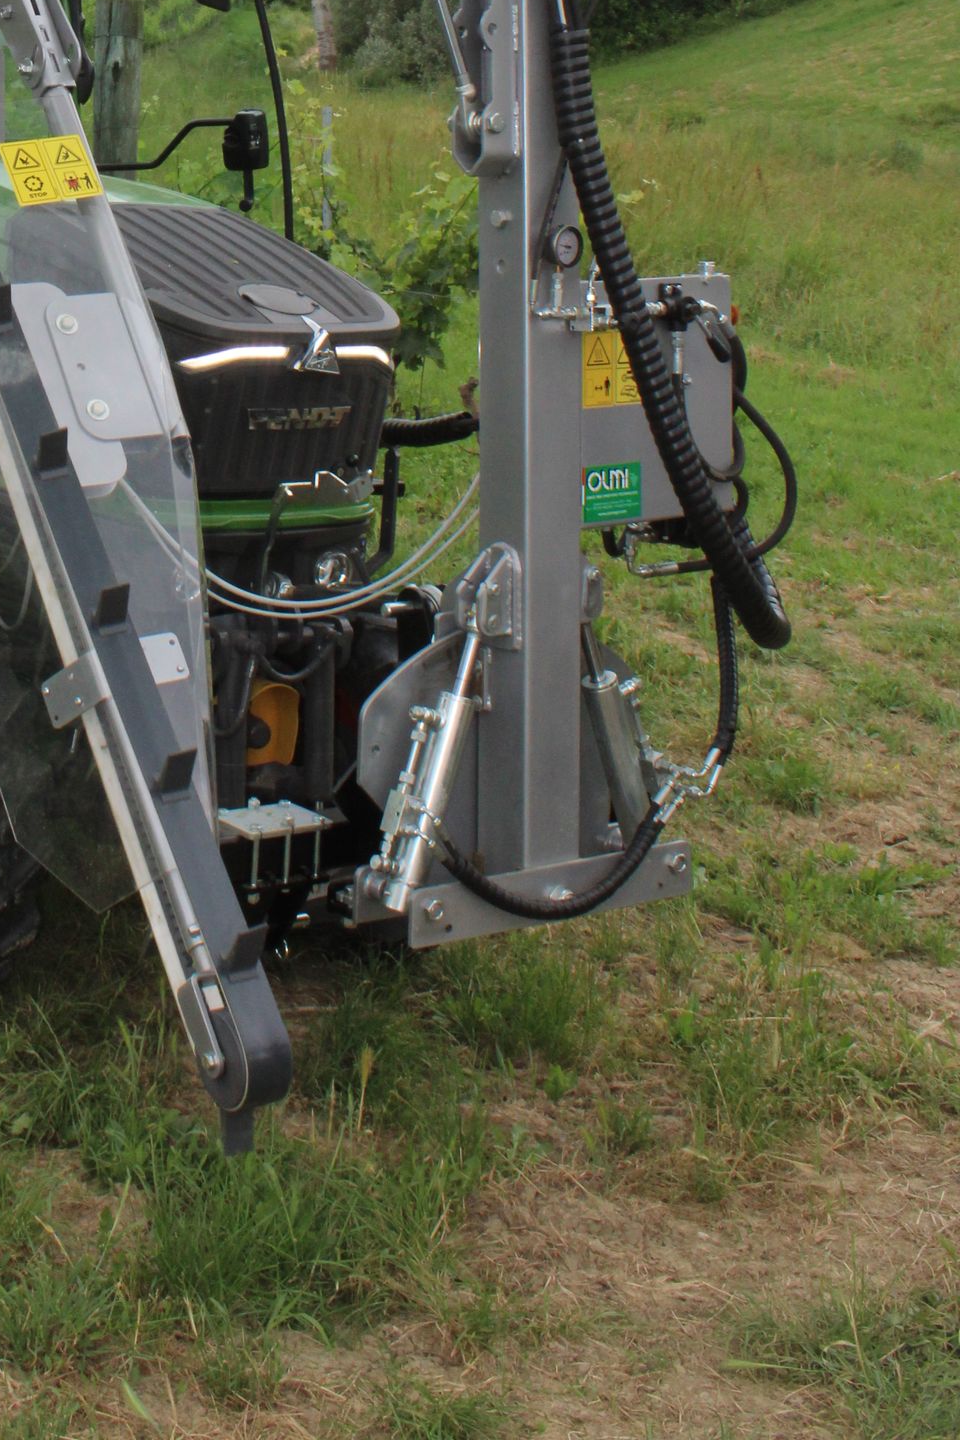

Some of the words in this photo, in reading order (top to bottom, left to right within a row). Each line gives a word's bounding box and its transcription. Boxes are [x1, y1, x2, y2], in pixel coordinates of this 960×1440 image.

[28, 191, 48, 199] STOP
[247, 405, 352, 430] FENDT
[587, 468, 629, 492] OLMI
